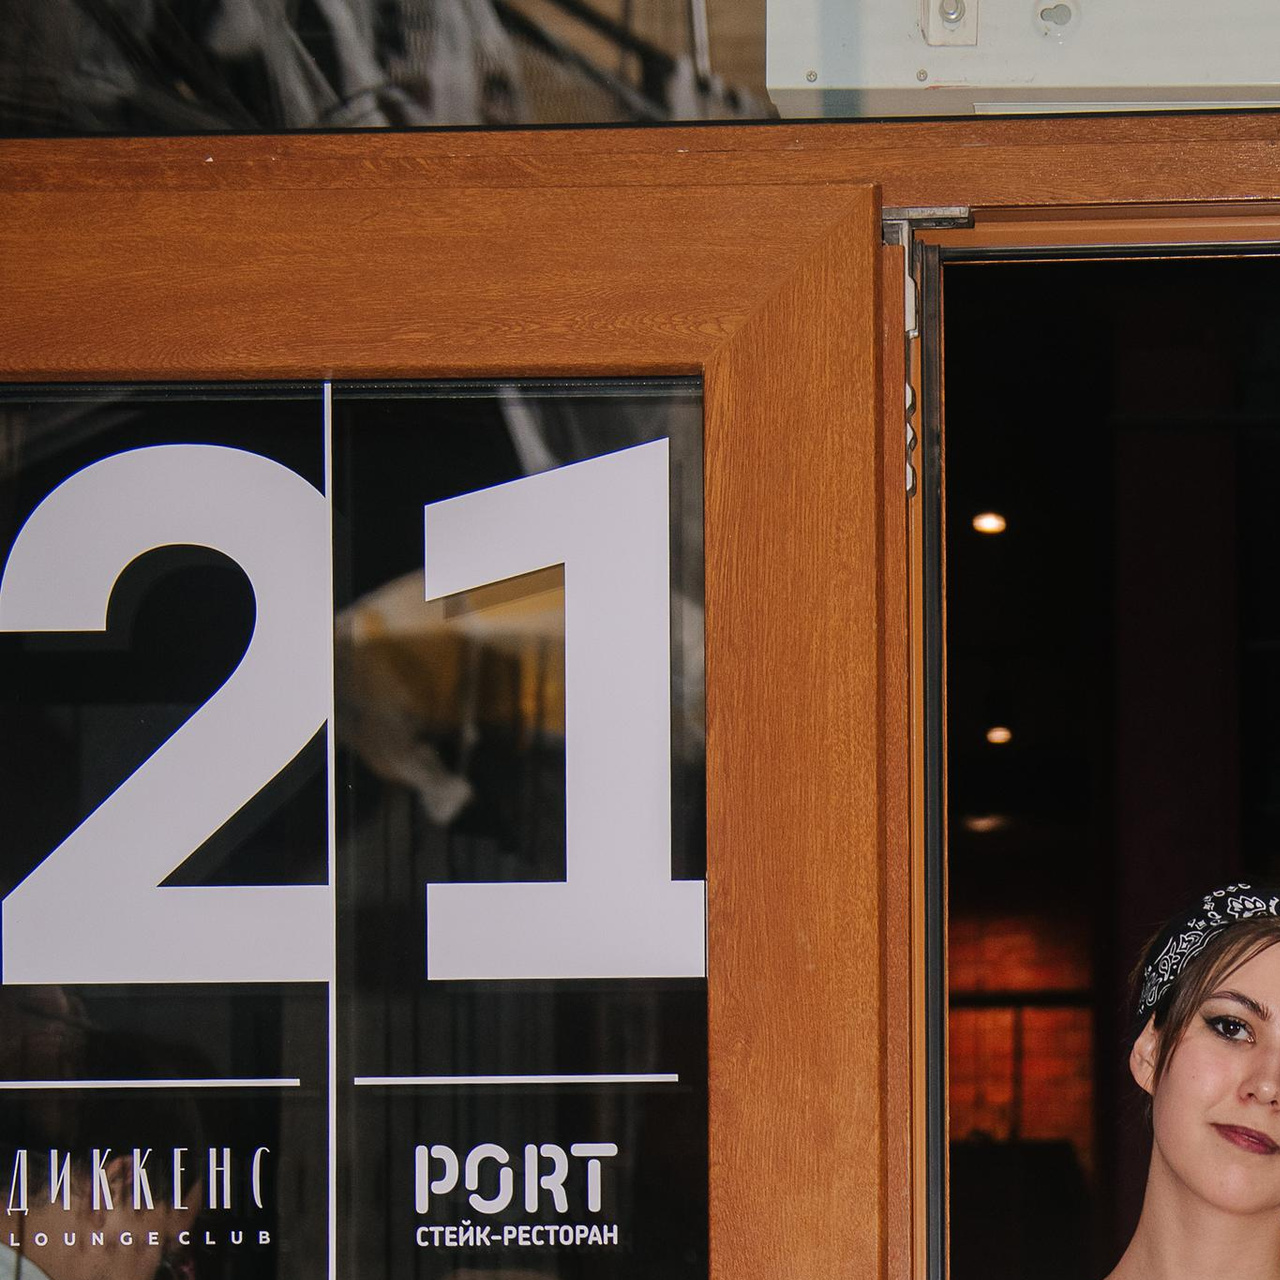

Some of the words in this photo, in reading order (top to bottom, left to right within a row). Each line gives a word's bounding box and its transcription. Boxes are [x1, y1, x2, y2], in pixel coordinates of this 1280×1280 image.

[7, 1147, 271, 1216] ДИККЕНС
[415, 1143, 618, 1214] PORT
[10, 1231, 159, 1247] LOUNGE
[178, 1230, 271, 1246] CLUB
[416, 1219, 618, 1247] СТЕЙК-РЕСТОРАН
